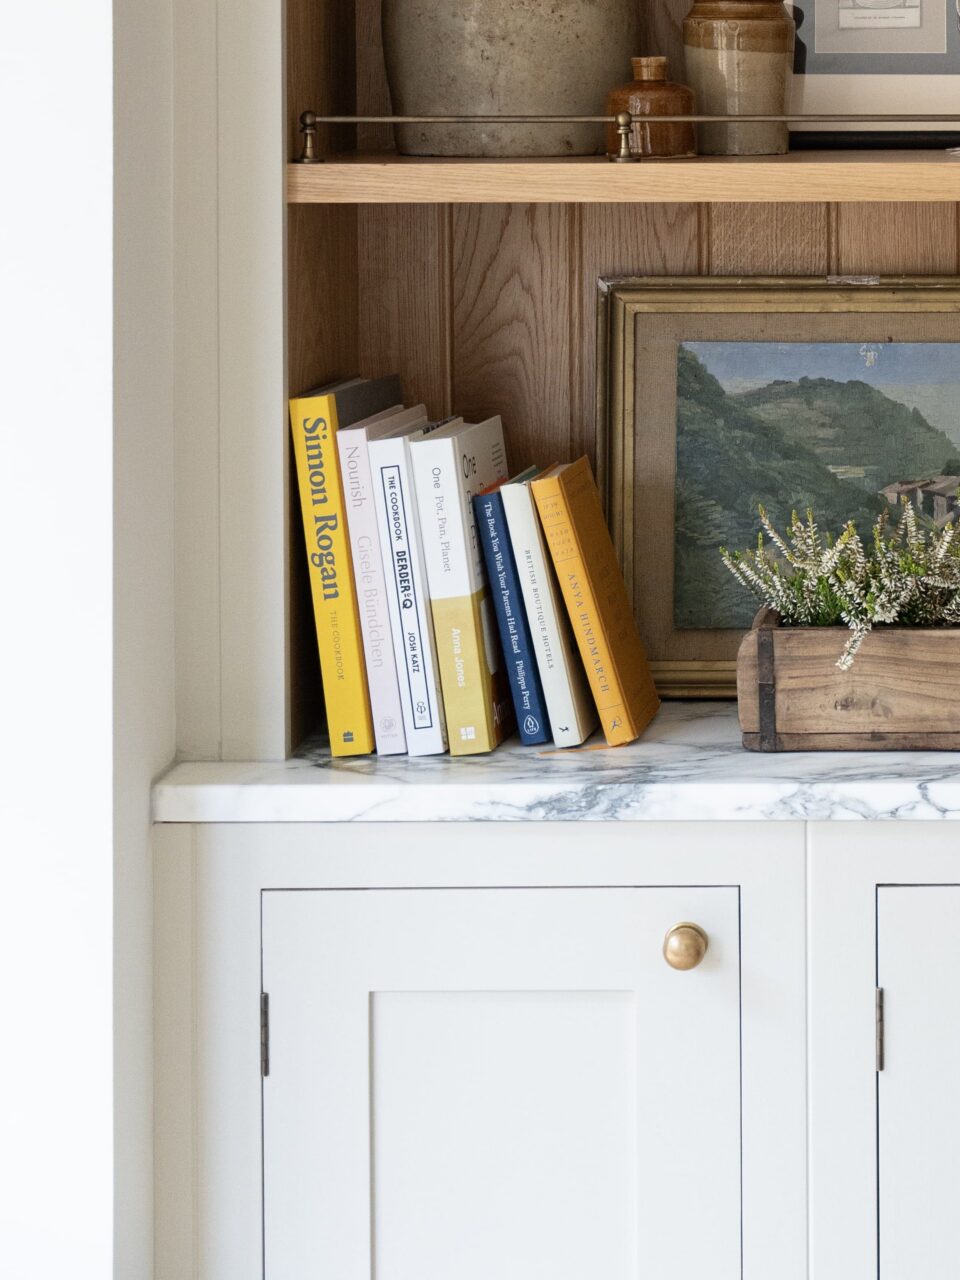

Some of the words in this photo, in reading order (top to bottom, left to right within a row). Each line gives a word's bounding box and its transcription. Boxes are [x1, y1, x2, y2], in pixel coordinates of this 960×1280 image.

[303, 417, 328, 506] Simon
[462, 453, 477, 479] One
[345, 446, 367, 508] Nourish
[387, 476, 396, 490] THE
[431, 467, 441, 489] One
[390, 492, 403, 541] COOKBOOK
[435, 496, 444, 516] Pot,
[484, 501, 492, 517] The
[438, 518, 447, 540] Pan,
[487, 518, 497, 538] Book
[311, 513, 340, 600] Rogan
[441, 541, 451, 572] Planet
[491, 537, 500, 553] You
[357, 535, 376, 584] Gisele
[495, 551, 504, 572] Wish
[498, 571, 507, 589] Your
[502, 589, 512, 617] Parents
[525, 549, 537, 585] BRITISH
[533, 587, 547, 632] BOUTIQUE
[542, 635, 554, 670] HOTELS
[329, 610, 338, 628] THE
[364, 588, 385, 668] Bündchen
[507, 618, 517, 634] Had
[408, 632, 417, 652] JOSH
[451, 628, 461, 654] Anna
[510, 634, 521, 654] Read
[568, 574, 584, 608] ANYA
[580, 613, 610, 693] HINDMARCH
[332, 630, 345, 680] COOKBOOK
[411, 654, 420, 673] KATZ
[455, 659, 466, 687] Jones
[516, 660, 526, 690] Philippa
[522, 691, 531, 710] Perry
